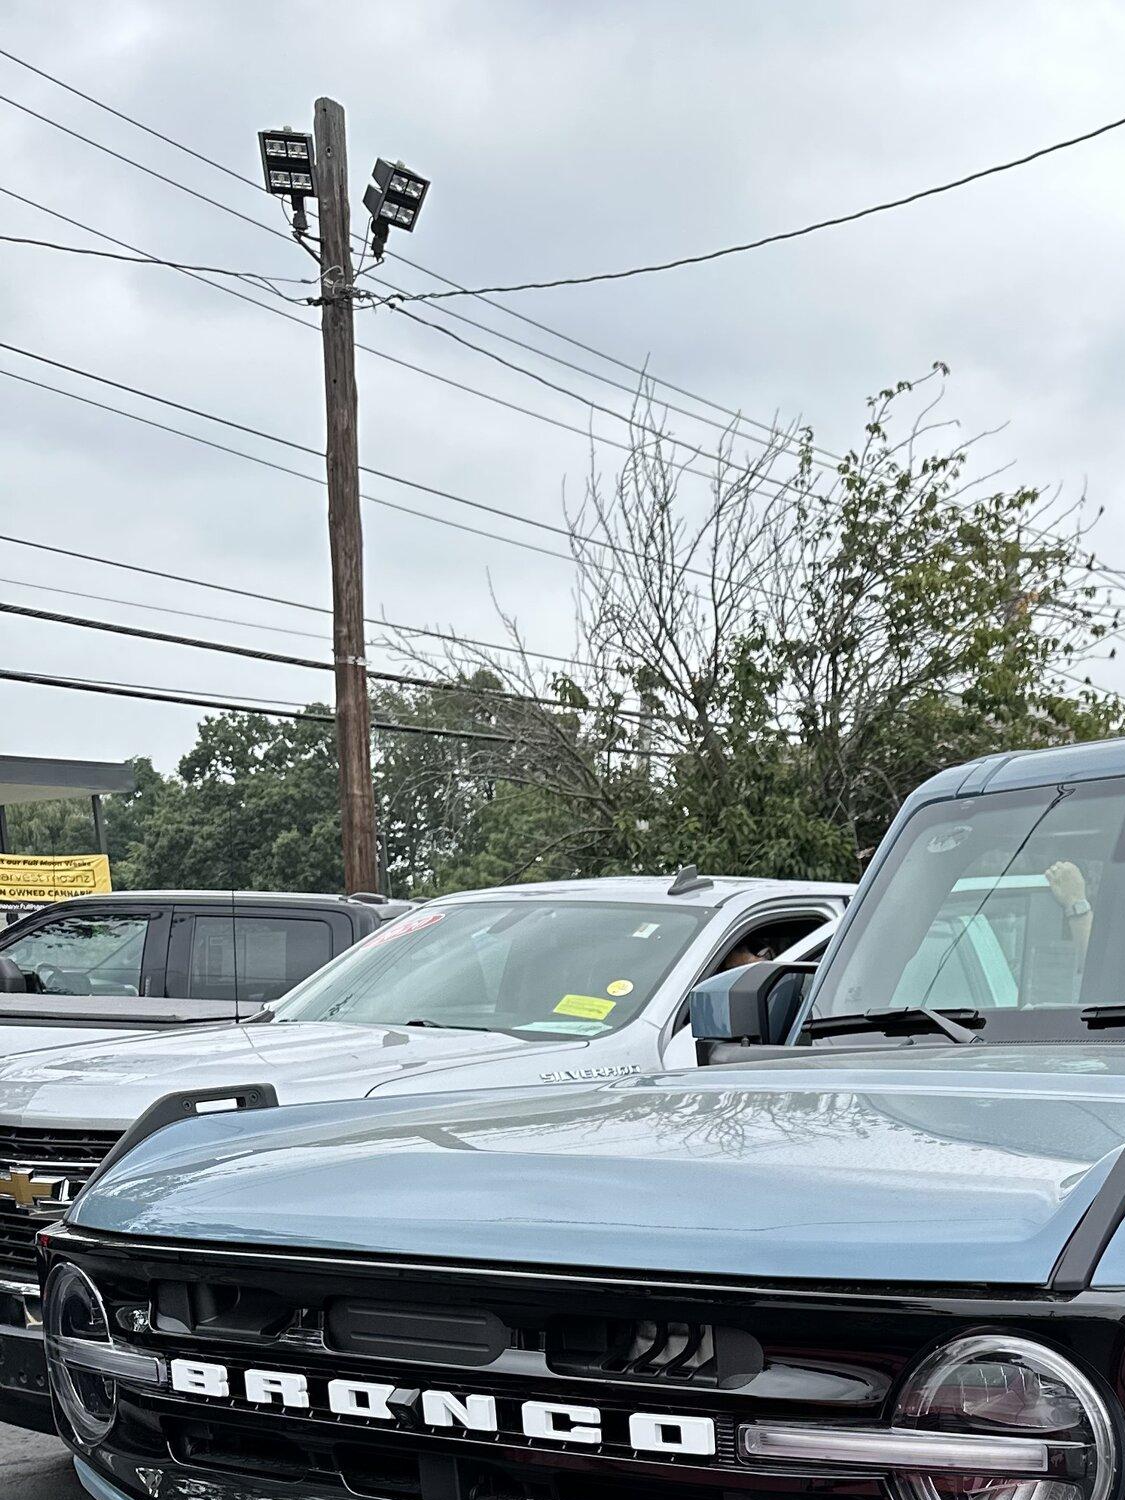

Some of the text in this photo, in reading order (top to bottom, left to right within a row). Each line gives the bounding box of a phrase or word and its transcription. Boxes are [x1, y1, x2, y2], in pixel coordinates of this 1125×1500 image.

[9, 889, 46, 897] OWNED
[540, 1064, 642, 1083] SILVERADO
[170, 1357, 717, 1457] BRONCO
